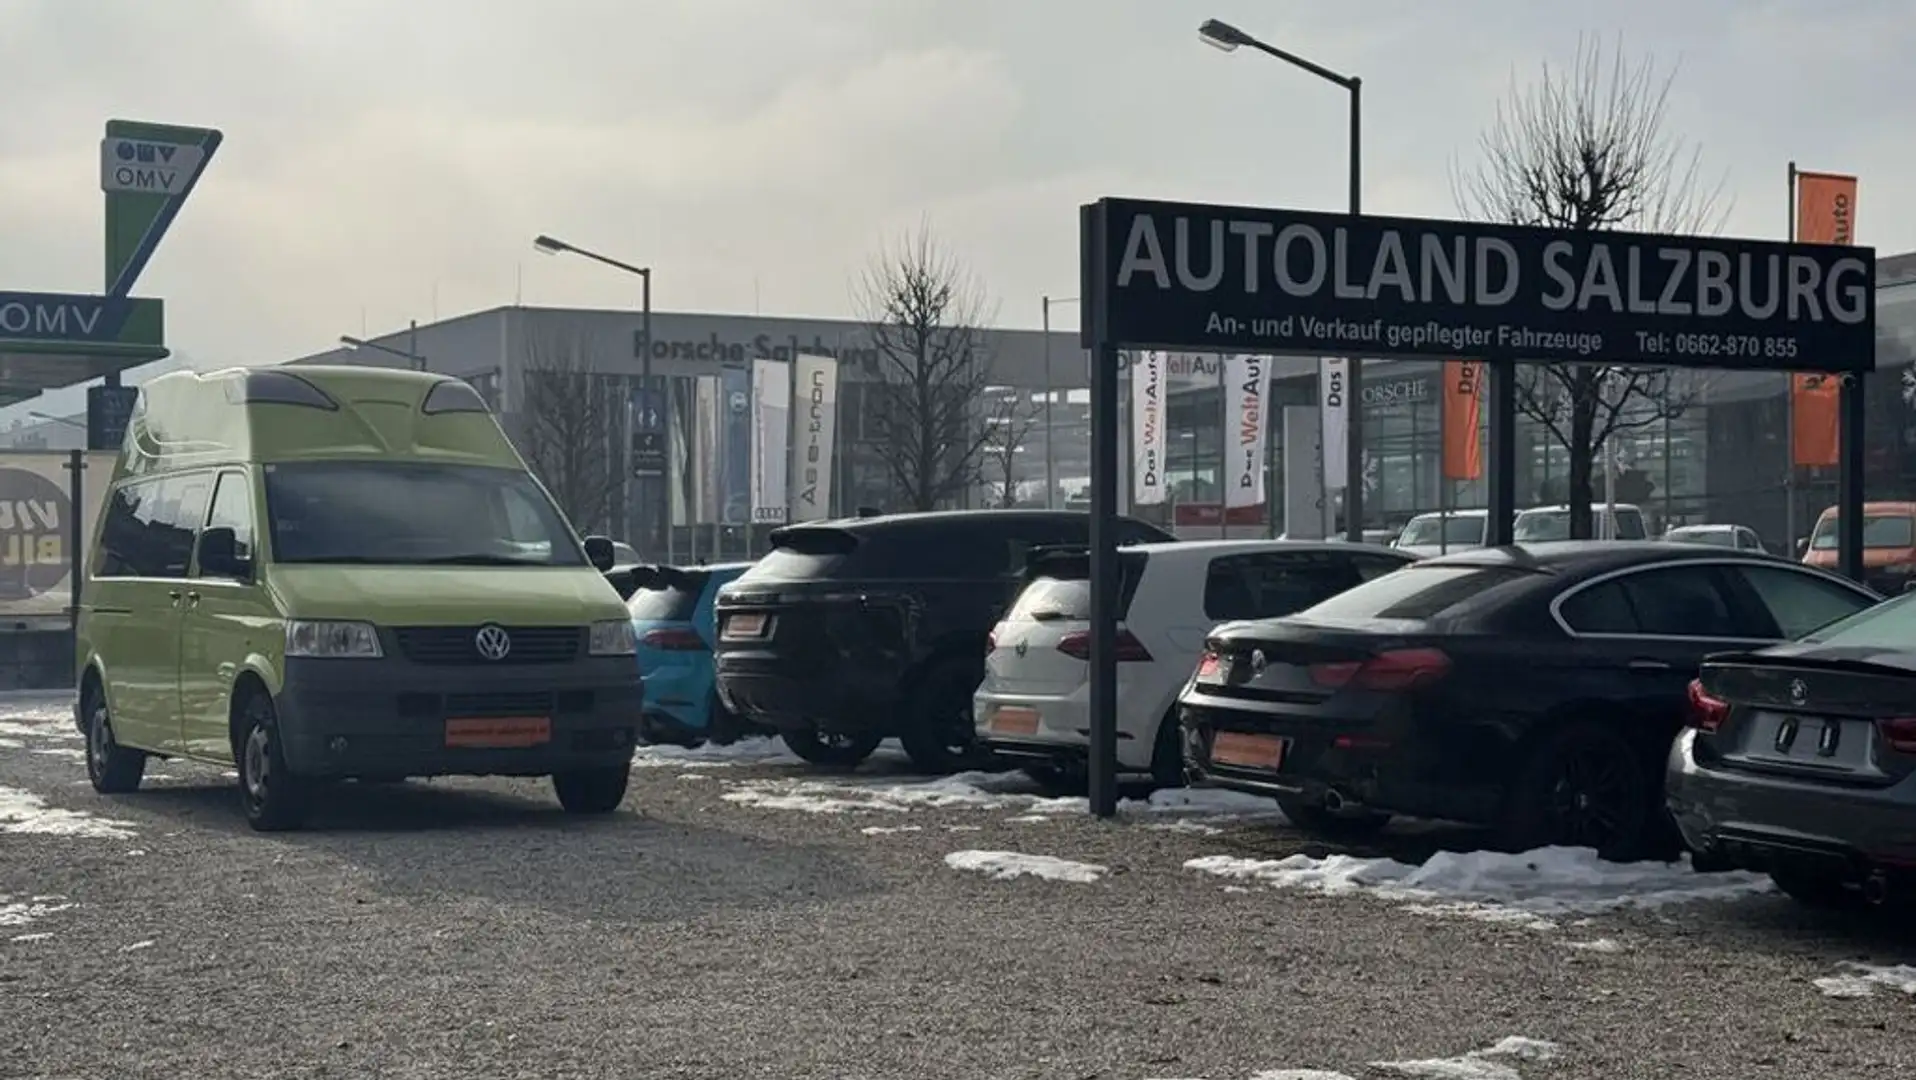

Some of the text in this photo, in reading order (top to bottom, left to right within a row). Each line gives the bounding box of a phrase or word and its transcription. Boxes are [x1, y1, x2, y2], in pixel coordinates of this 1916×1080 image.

[115, 167, 176, 188] OMV
[1117, 213, 1868, 325] AUTOLAND SALZBURG
[0, 302, 103, 335] OMV
[1206, 311, 1798, 358] An- und Verkauf gepflegter Fahrzeuge Tel: 0662-870 855
[1240, 357, 1261, 446] WeltAut
[1328, 371, 1342, 407] Das
[1361, 379, 1428, 402] ORSCHE
[1144, 449, 1157, 487] Das
